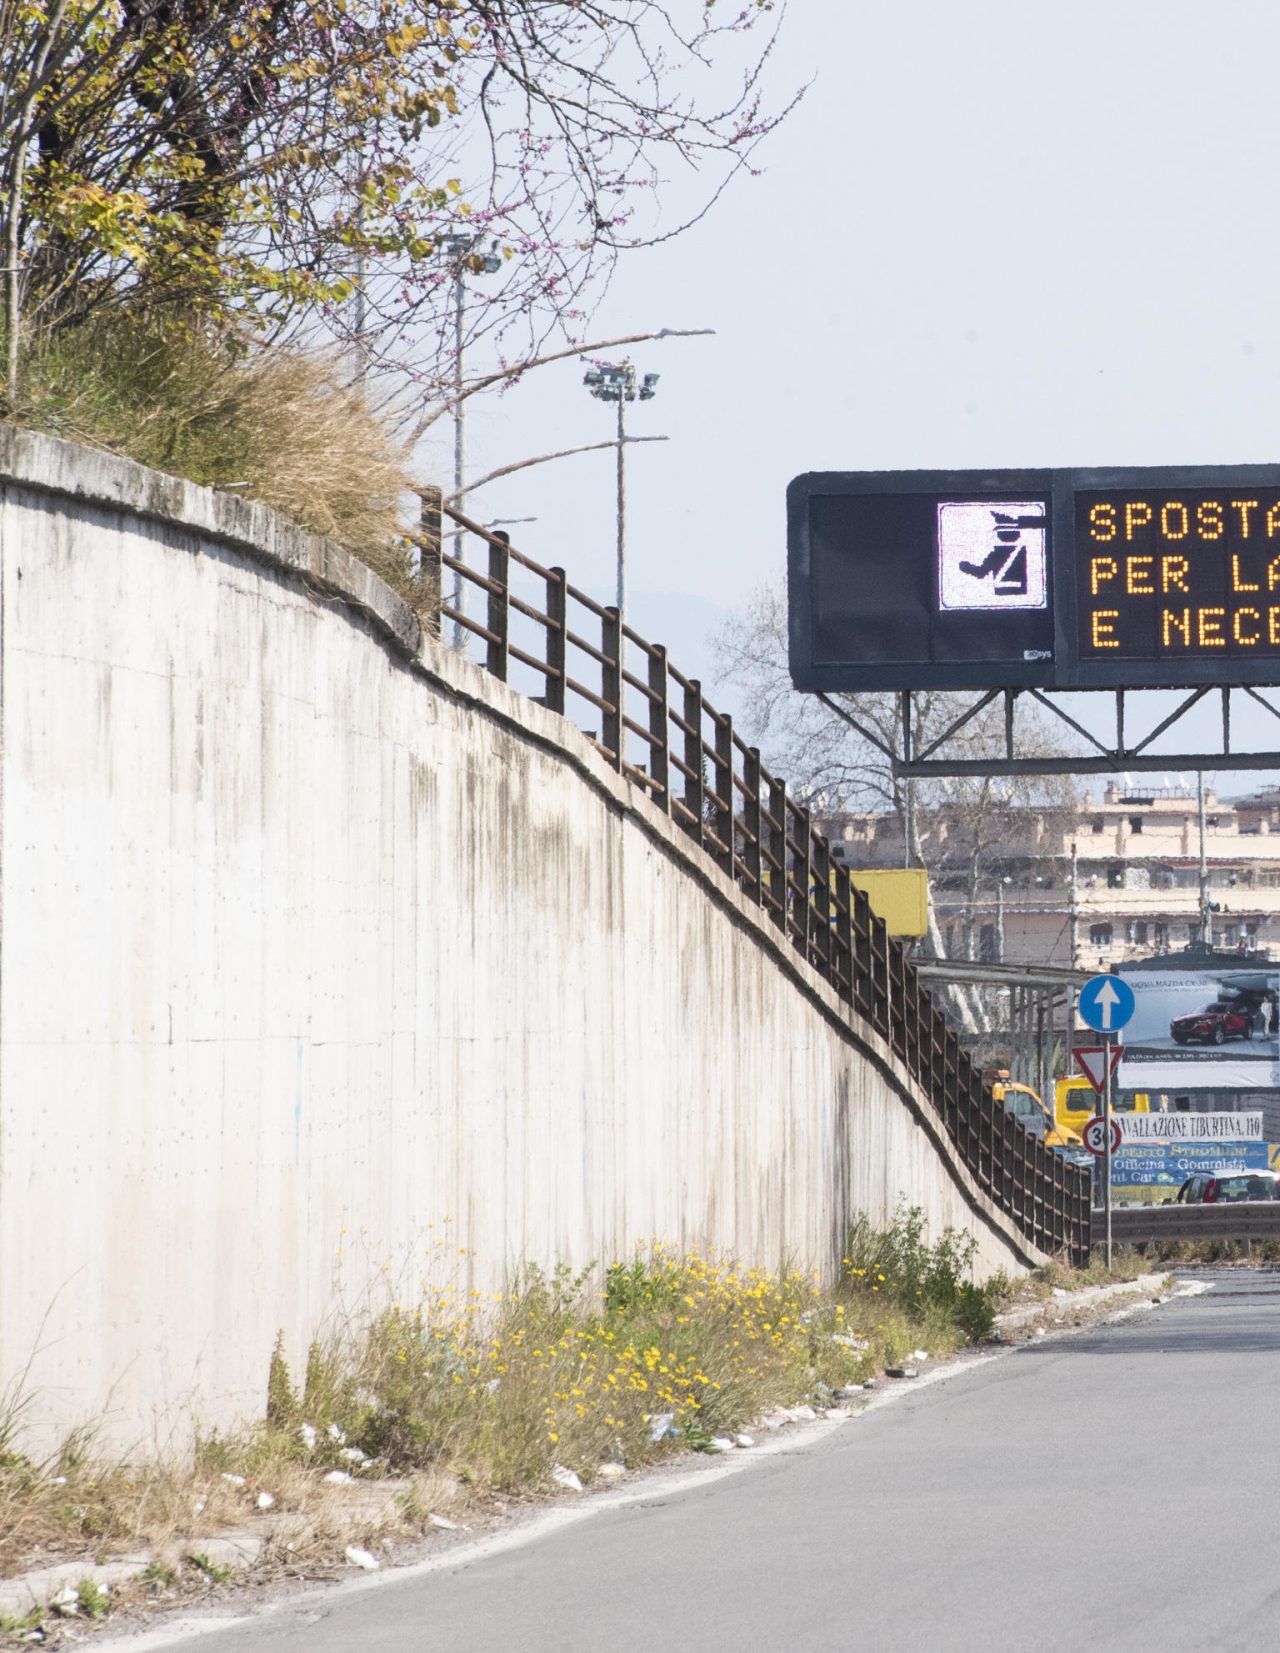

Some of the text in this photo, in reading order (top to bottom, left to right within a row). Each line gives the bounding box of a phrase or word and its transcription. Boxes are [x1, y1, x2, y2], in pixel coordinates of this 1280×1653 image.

[1091, 555, 1189, 595] PER
[1091, 610, 1120, 648] E
[1114, 1158, 1165, 1170] Officina
[1177, 1157, 1247, 1169] Gommista
